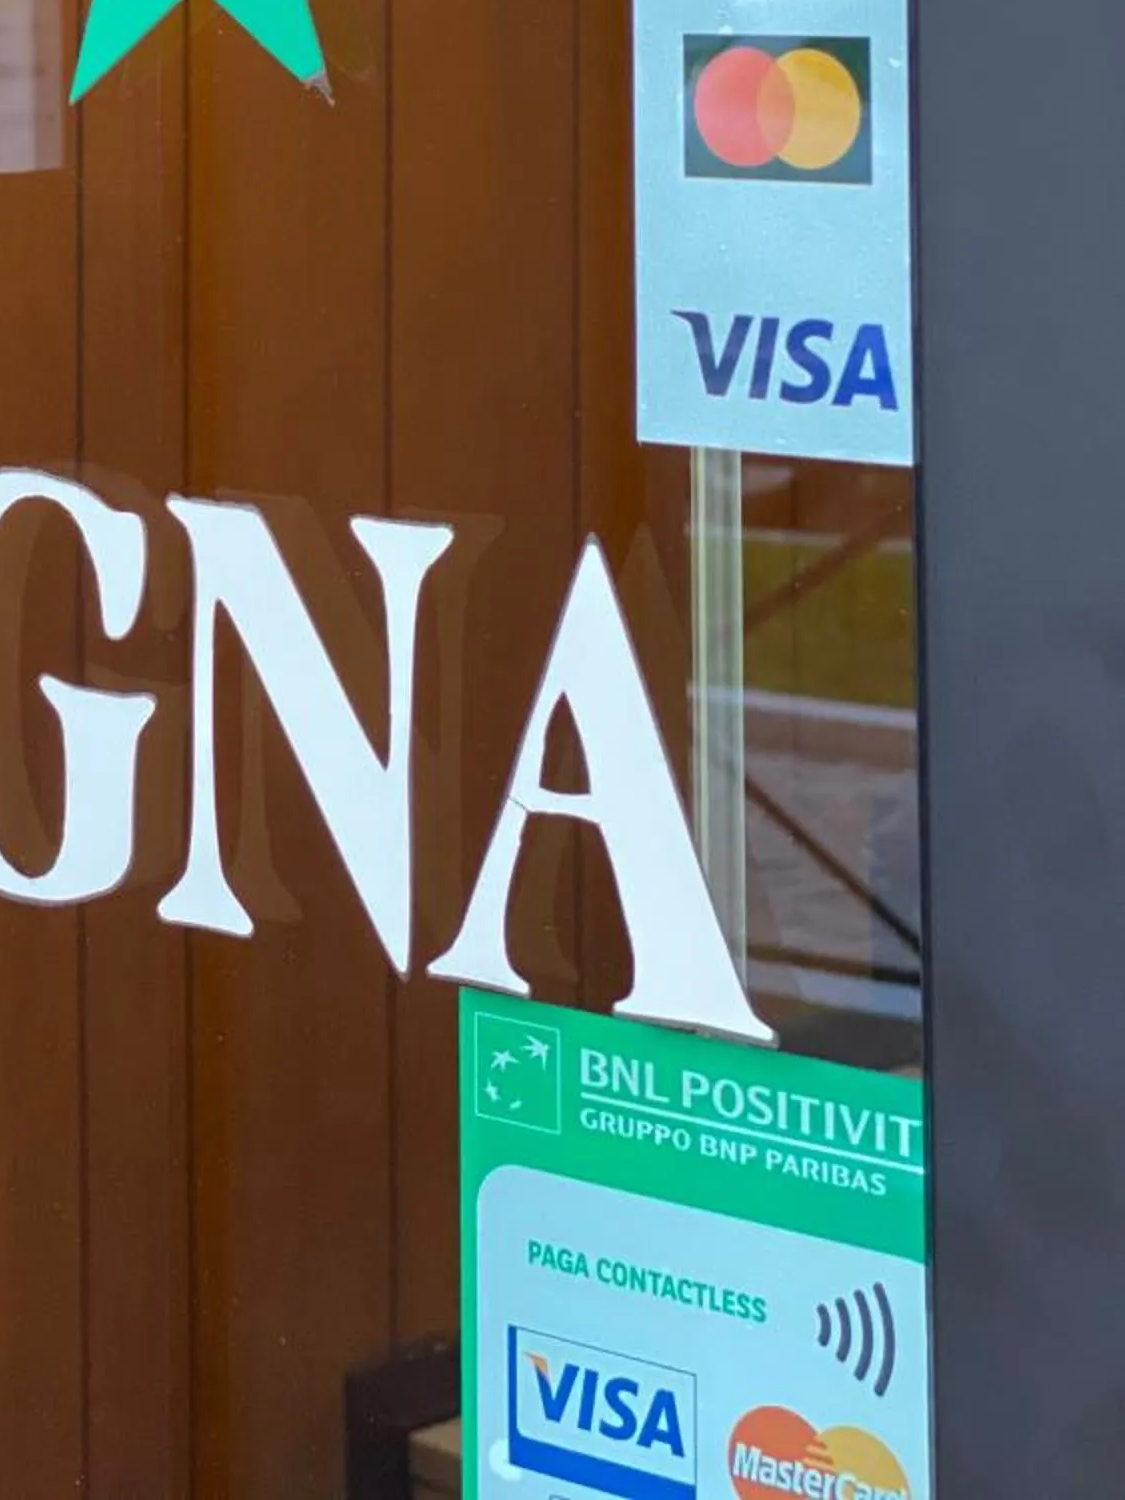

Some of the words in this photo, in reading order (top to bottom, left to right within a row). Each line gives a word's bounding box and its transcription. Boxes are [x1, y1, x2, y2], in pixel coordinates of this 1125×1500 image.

[671, 309, 899, 411] VISA
[580, 1047, 669, 1104] BNL
[580, 1107, 692, 1152] GRUPPO
[700, 1135, 758, 1167] BNP
[765, 1150, 888, 1197] PARIBAS
[527, 1240, 589, 1280] PAGA
[596, 1254, 768, 1325] CONTACTLESS
[523, 1351, 686, 1460] VISA
